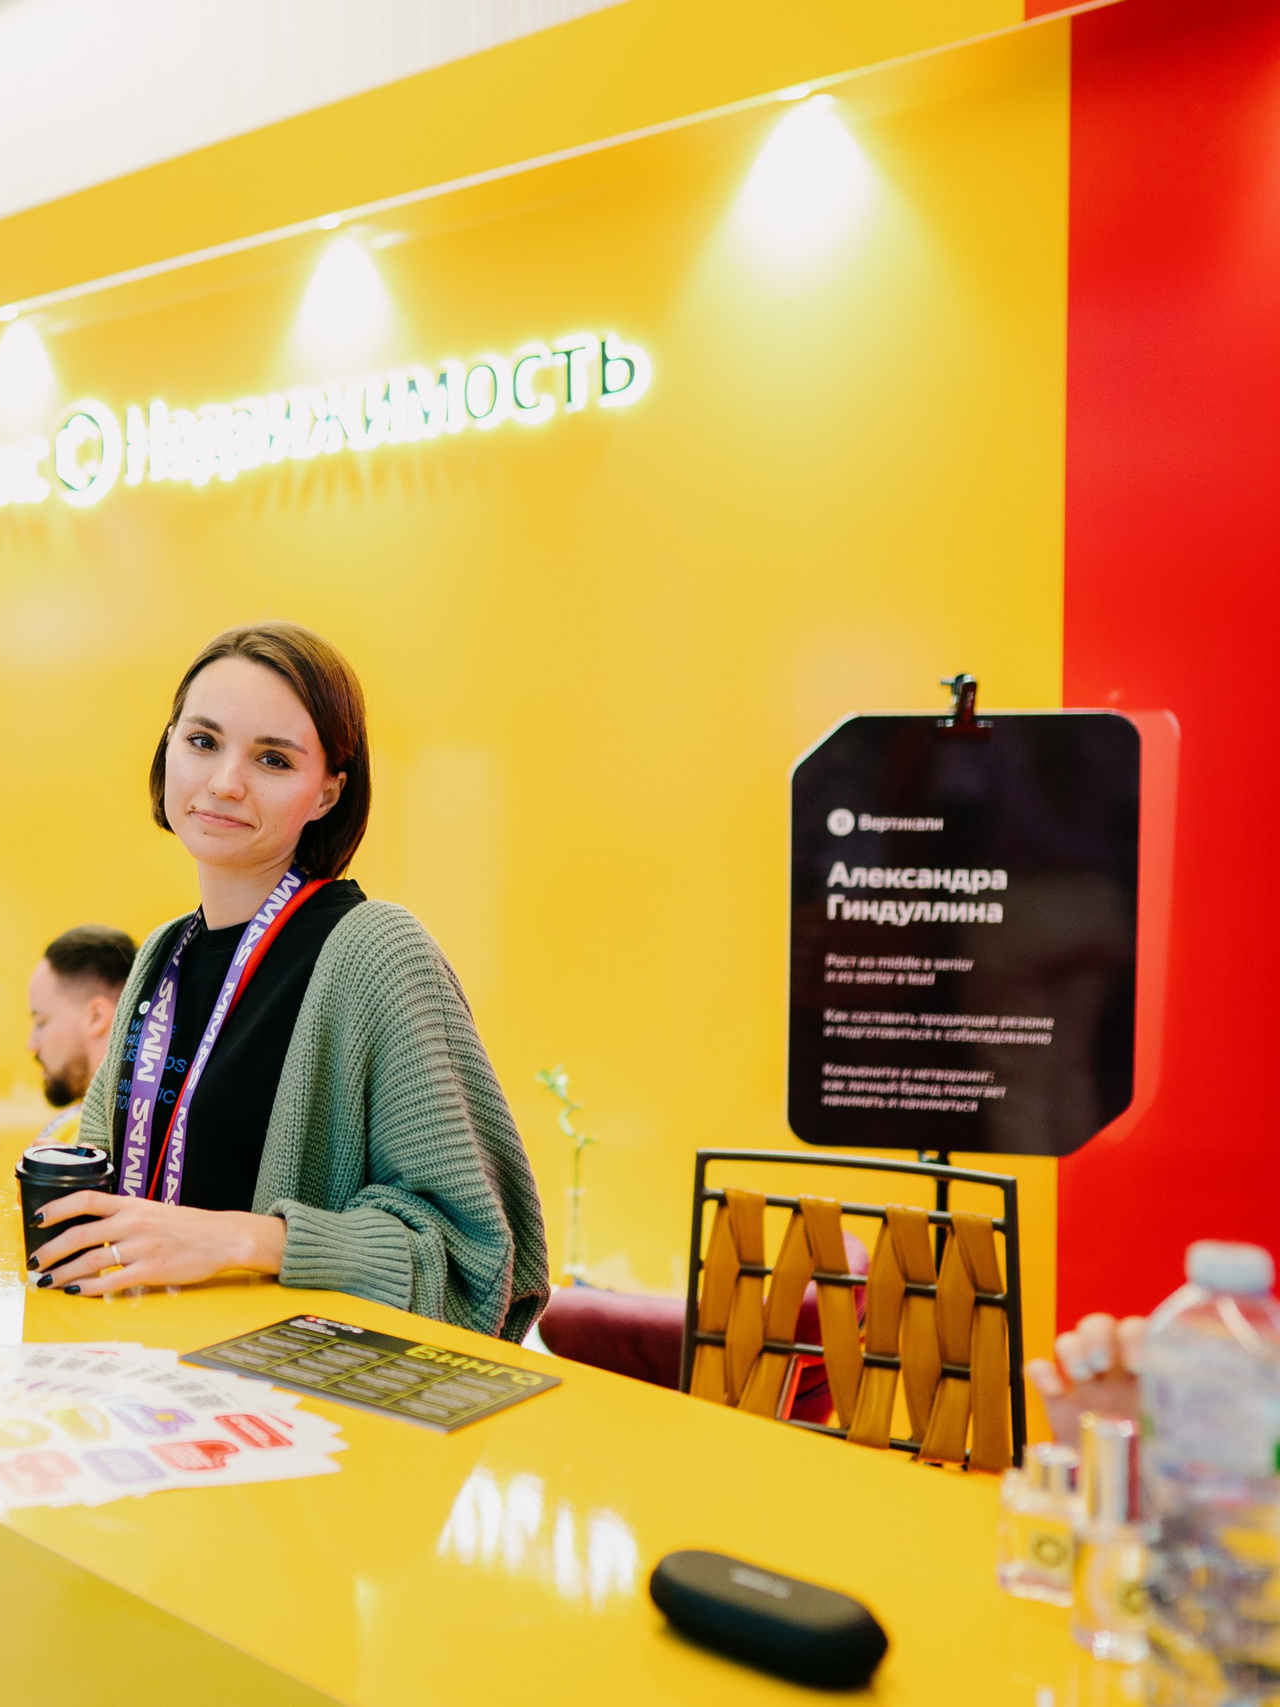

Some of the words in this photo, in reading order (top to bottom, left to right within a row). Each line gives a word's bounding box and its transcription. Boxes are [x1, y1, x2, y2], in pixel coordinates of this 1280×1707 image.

[124, 334, 651, 486] Недвижимость
[858, 814, 945, 833] Вертикали
[827, 861, 1008, 894] Александра
[827, 893, 1004, 926] Гиндуллина
[825, 953, 857, 968] Рост
[858, 956, 876, 968] из
[877, 955, 921, 970] middle
[933, 957, 974, 971] senior
[837, 972, 854, 983] из
[855, 971, 894, 984] senior
[908, 972, 936, 985] lead
[823, 1008, 849, 1023] Как
[851, 1010, 917, 1025] составить
[919, 1013, 998, 1029] продающее
[999, 1015, 1055, 1030] резюме
[823, 1026, 835, 1037] и
[836, 1026, 933, 1040] подготовиться
[944, 1028, 1053, 1045] собеседованию
[822, 1080, 846, 1091] как
[847, 1079, 898, 1094] личный
[899, 1081, 941, 1096] бренд
[942, 1084, 1007, 1098] помогает
[822, 1095, 886, 1108] нанимать
[899, 1098, 979, 1112] наниматься
